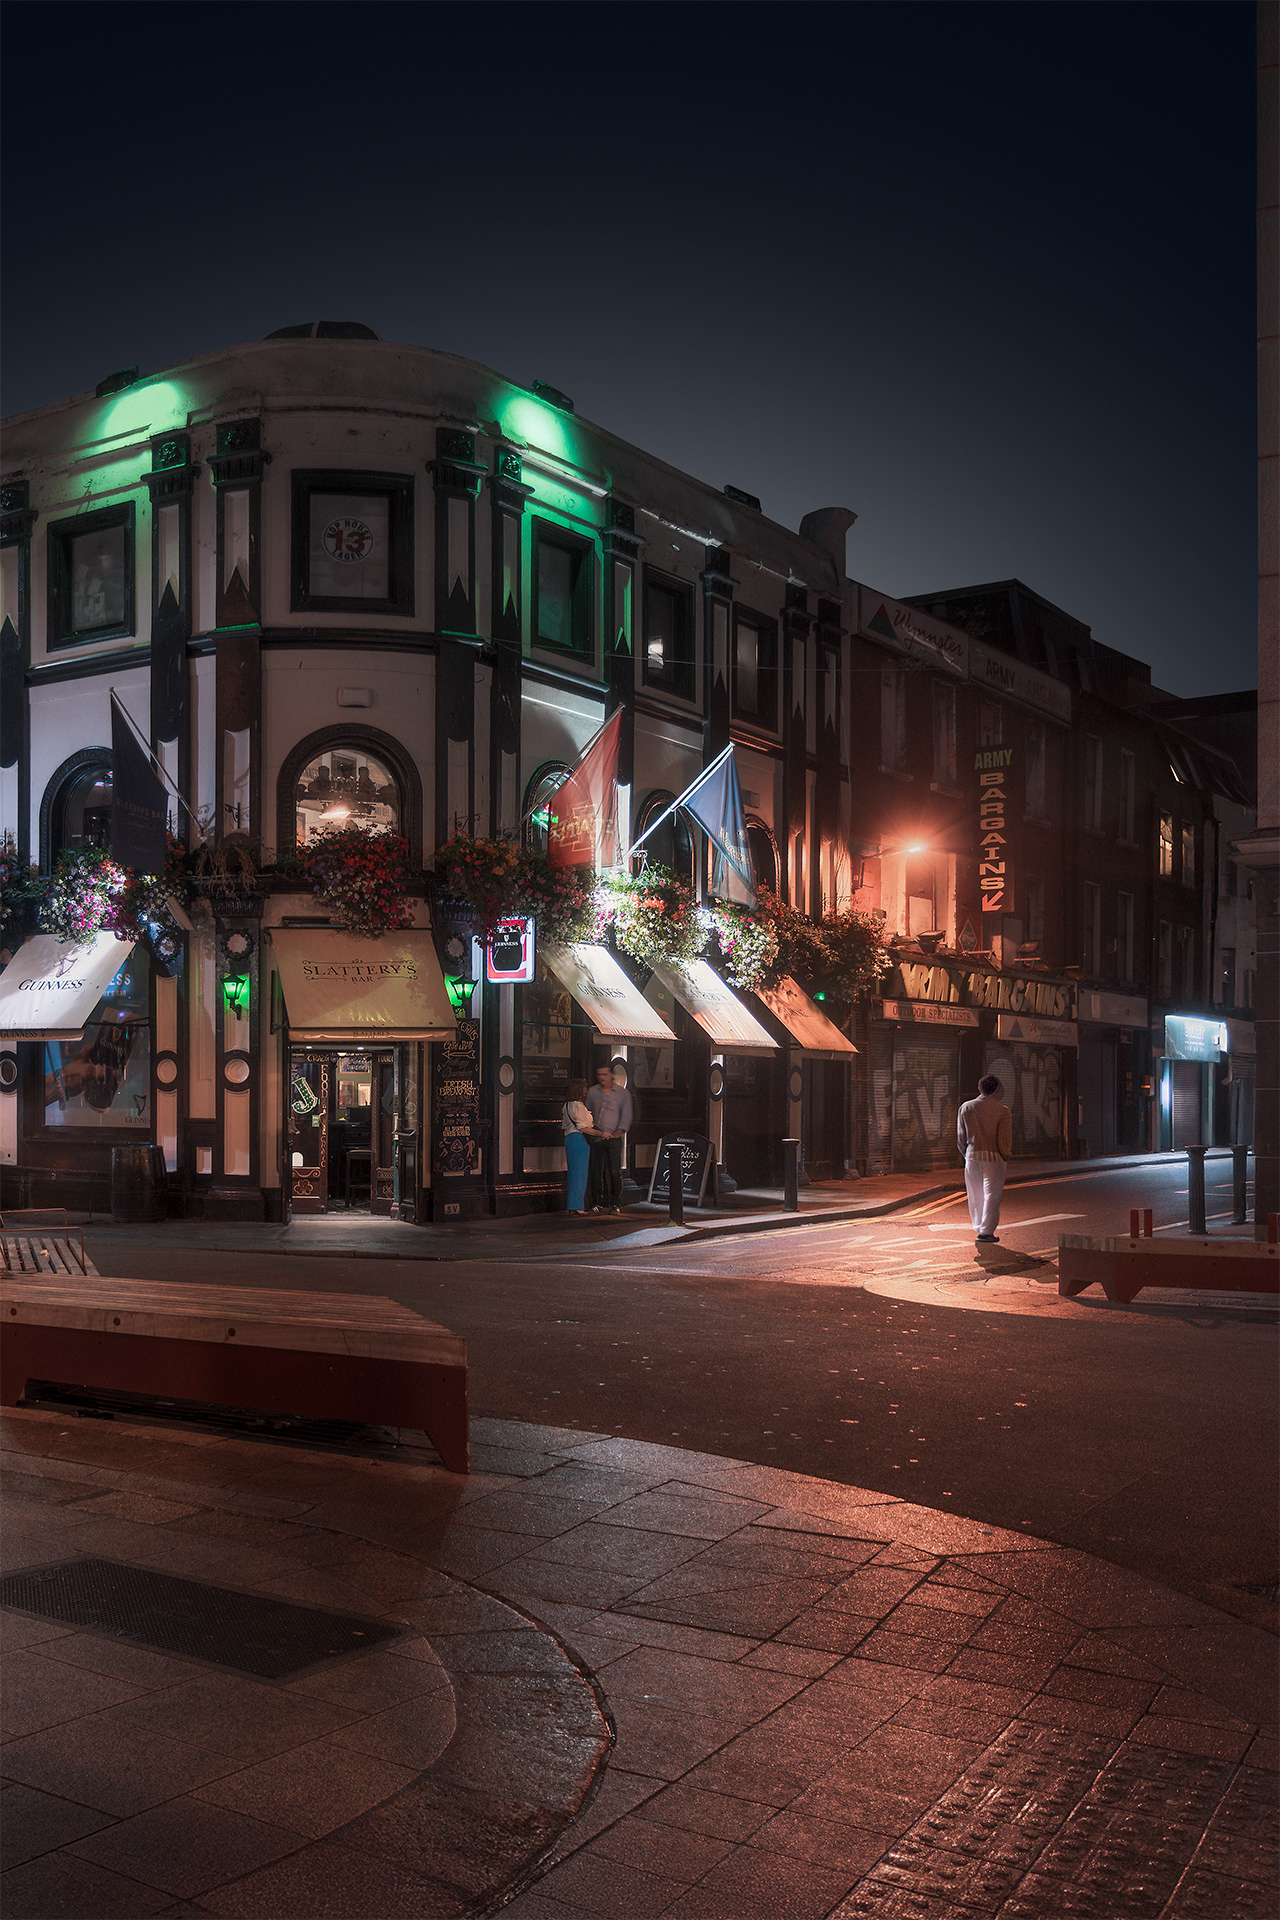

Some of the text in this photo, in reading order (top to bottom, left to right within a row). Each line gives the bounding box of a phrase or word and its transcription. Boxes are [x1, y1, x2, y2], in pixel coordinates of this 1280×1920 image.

[326, 520, 371, 541] HOP HOUSE
[332, 529, 366, 553] 13
[332, 548, 363, 560] LAGER
[893, 609, 964, 657] Wynnster
[985, 658, 1016, 689] ARMY
[974, 749, 1013, 770] ARMY
[979, 772, 1007, 890] BARGAINS
[303, 964, 417, 977] SLATTERY'S
[351, 975, 374, 983] BAR
[18, 978, 86, 992] GUINNESS
[577, 981, 626, 999] GUINNESS
[888, 962, 966, 1004] ARMY
[892, 1005, 972, 1023] OUTDOOR SPECIALISTS
[0, 1029, 38, 1039] GUINNESS
[443, 1080, 473, 1088] IRISH
